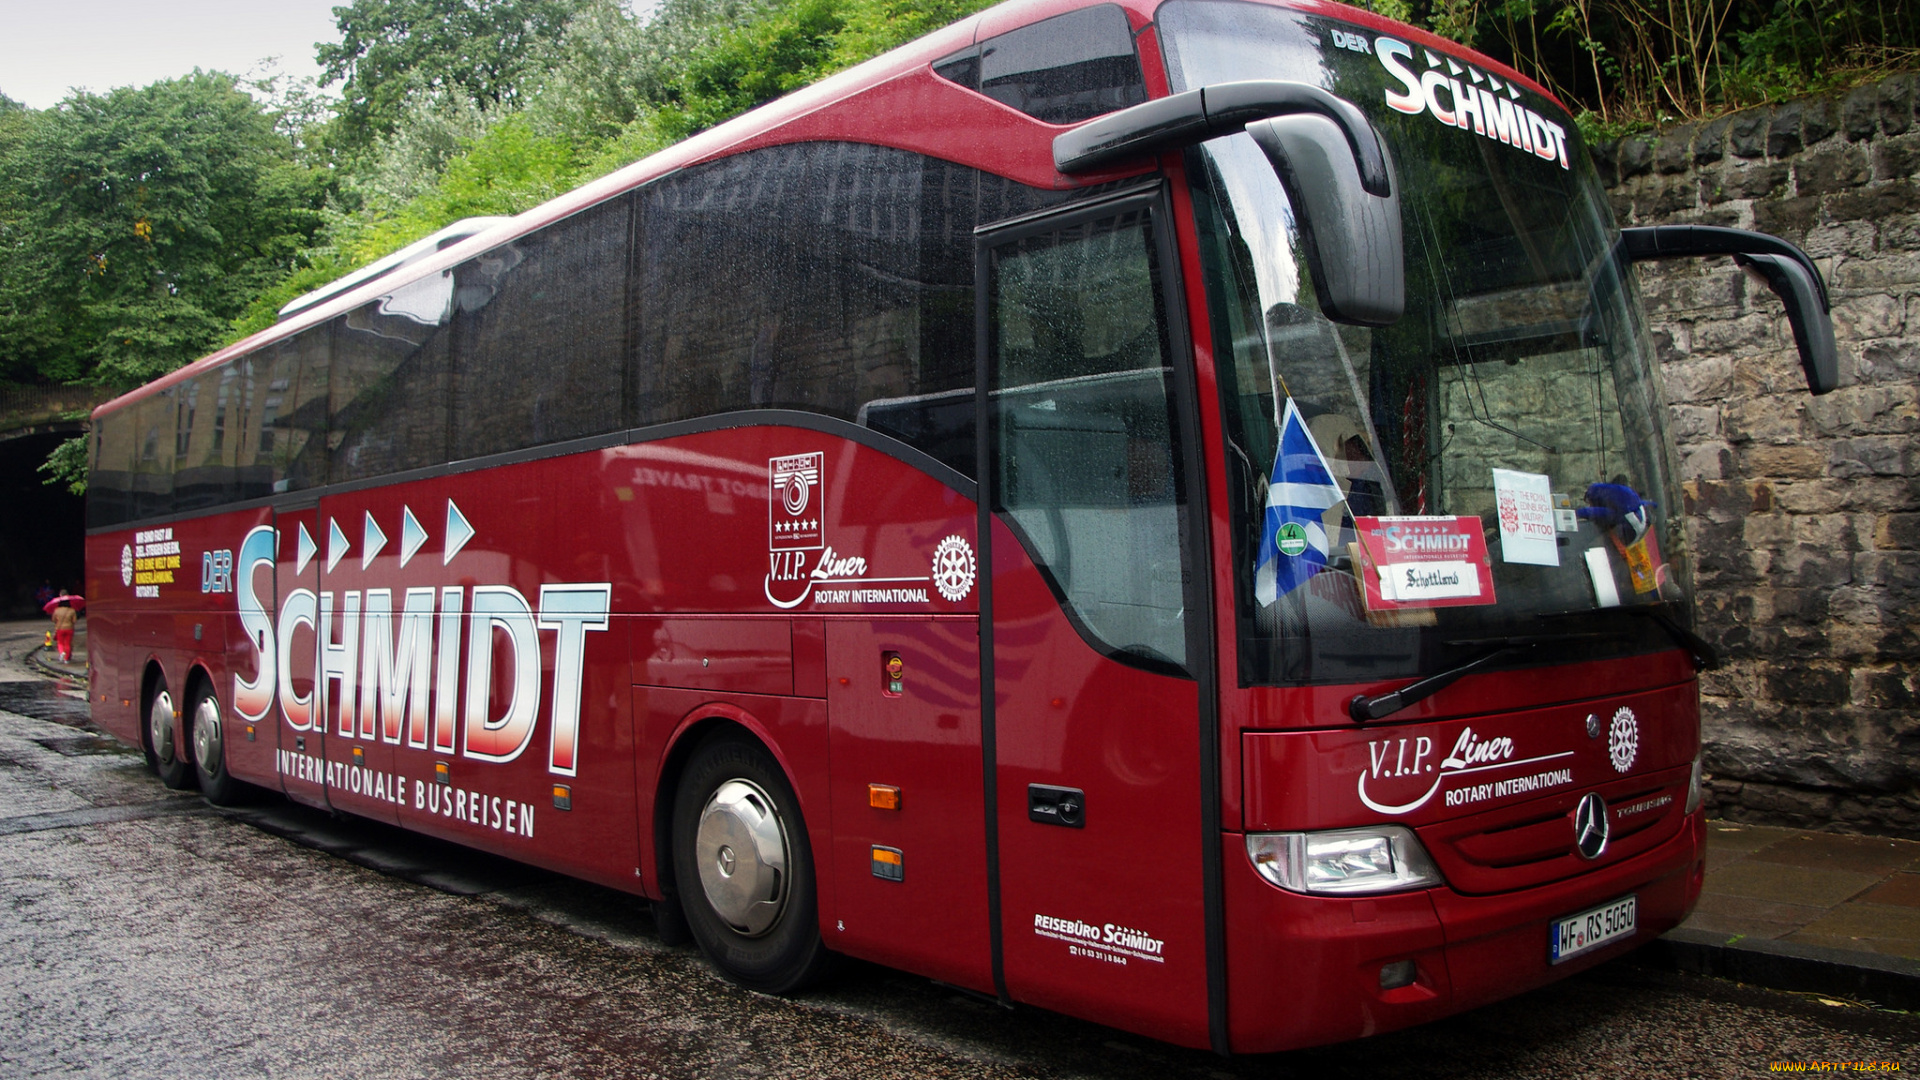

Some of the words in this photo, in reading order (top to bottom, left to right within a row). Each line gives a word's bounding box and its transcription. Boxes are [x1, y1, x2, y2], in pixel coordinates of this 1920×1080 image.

[1331, 29, 1372, 54] DER
[1374, 36, 1570, 171] SCHMIDT
[1519, 491, 1529, 500] THE
[1529, 492, 1546, 503] ROYAL
[1520, 501, 1550, 513] EDINBURGH
[1287, 525, 1296, 539] 4
[1521, 512, 1545, 522] MILITARY
[1523, 522, 1553, 535] TATTOO
[1386, 525, 1471, 554] SCHMIDT
[769, 551, 806, 581] V.I.P.
[810, 546, 867, 580] Liner
[815, 589, 850, 604] ROTARY
[852, 588, 930, 604] INTERNATIONAL
[202, 549, 233, 594] DER
[233, 524, 612, 778] SCHMIDT
[1369, 736, 1433, 780] V.I.P.
[1440, 727, 1514, 770] Liner
[276, 748, 406, 805] INTERNATIONALE
[415, 782, 535, 838] BUSREISEN
[1445, 784, 1492, 807] ROTARY
[1495, 768, 1573, 798] INTERNATIONAL
[1034, 913, 1100, 940] REISEBÜRO
[1103, 923, 1164, 954] SCHMIDT
[1560, 920, 1577, 952] WF
[1586, 912, 1602, 943] RS
[1605, 901, 1634, 935] 5050
